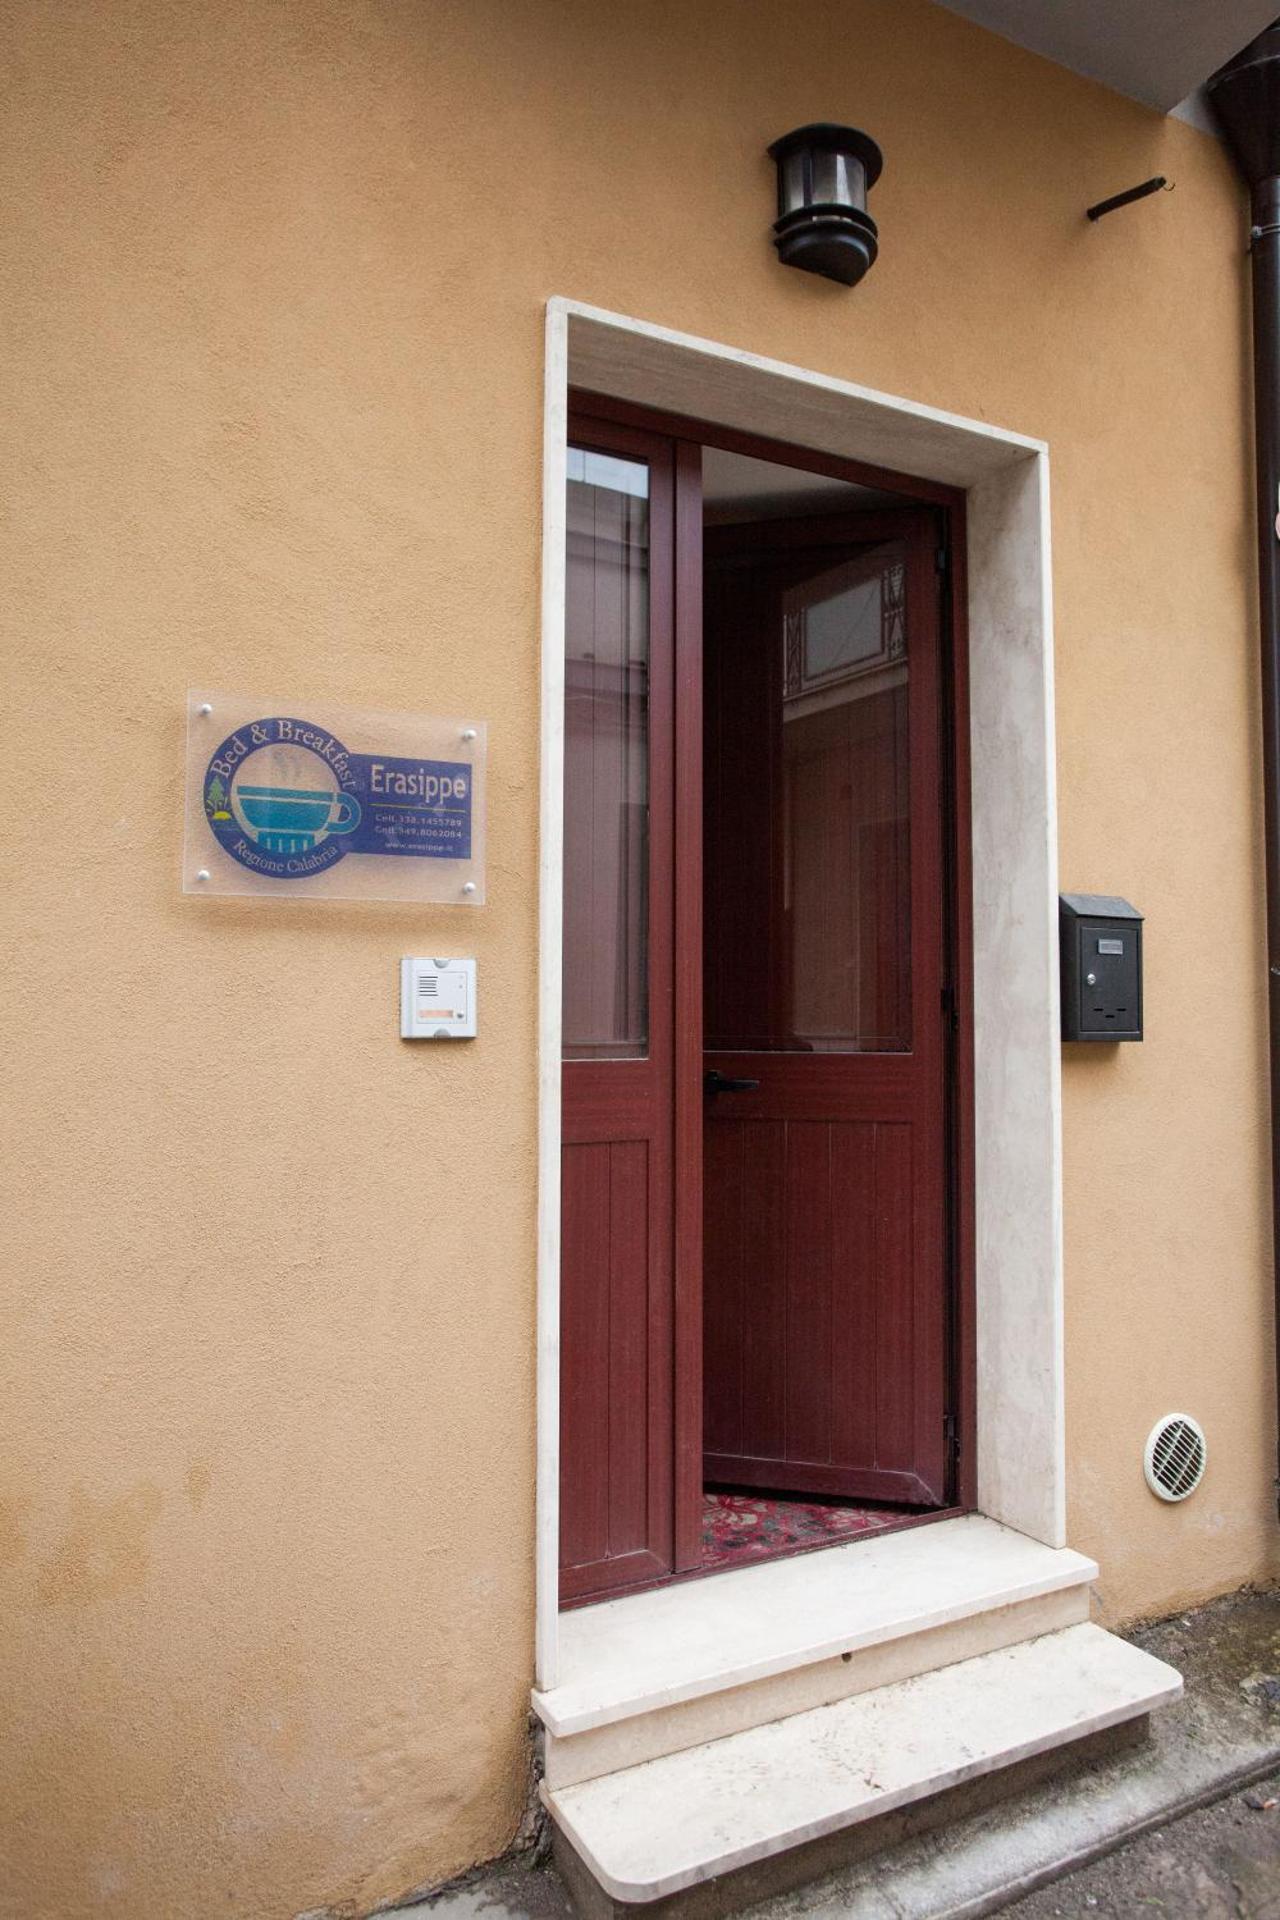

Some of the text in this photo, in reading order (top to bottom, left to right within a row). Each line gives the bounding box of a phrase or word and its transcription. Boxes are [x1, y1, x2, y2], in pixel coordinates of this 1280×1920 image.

[211, 720, 357, 790] Bed & Breakfast
[371, 764, 467, 804] Erasippe
[233, 839, 339, 873] Regione Calabria
